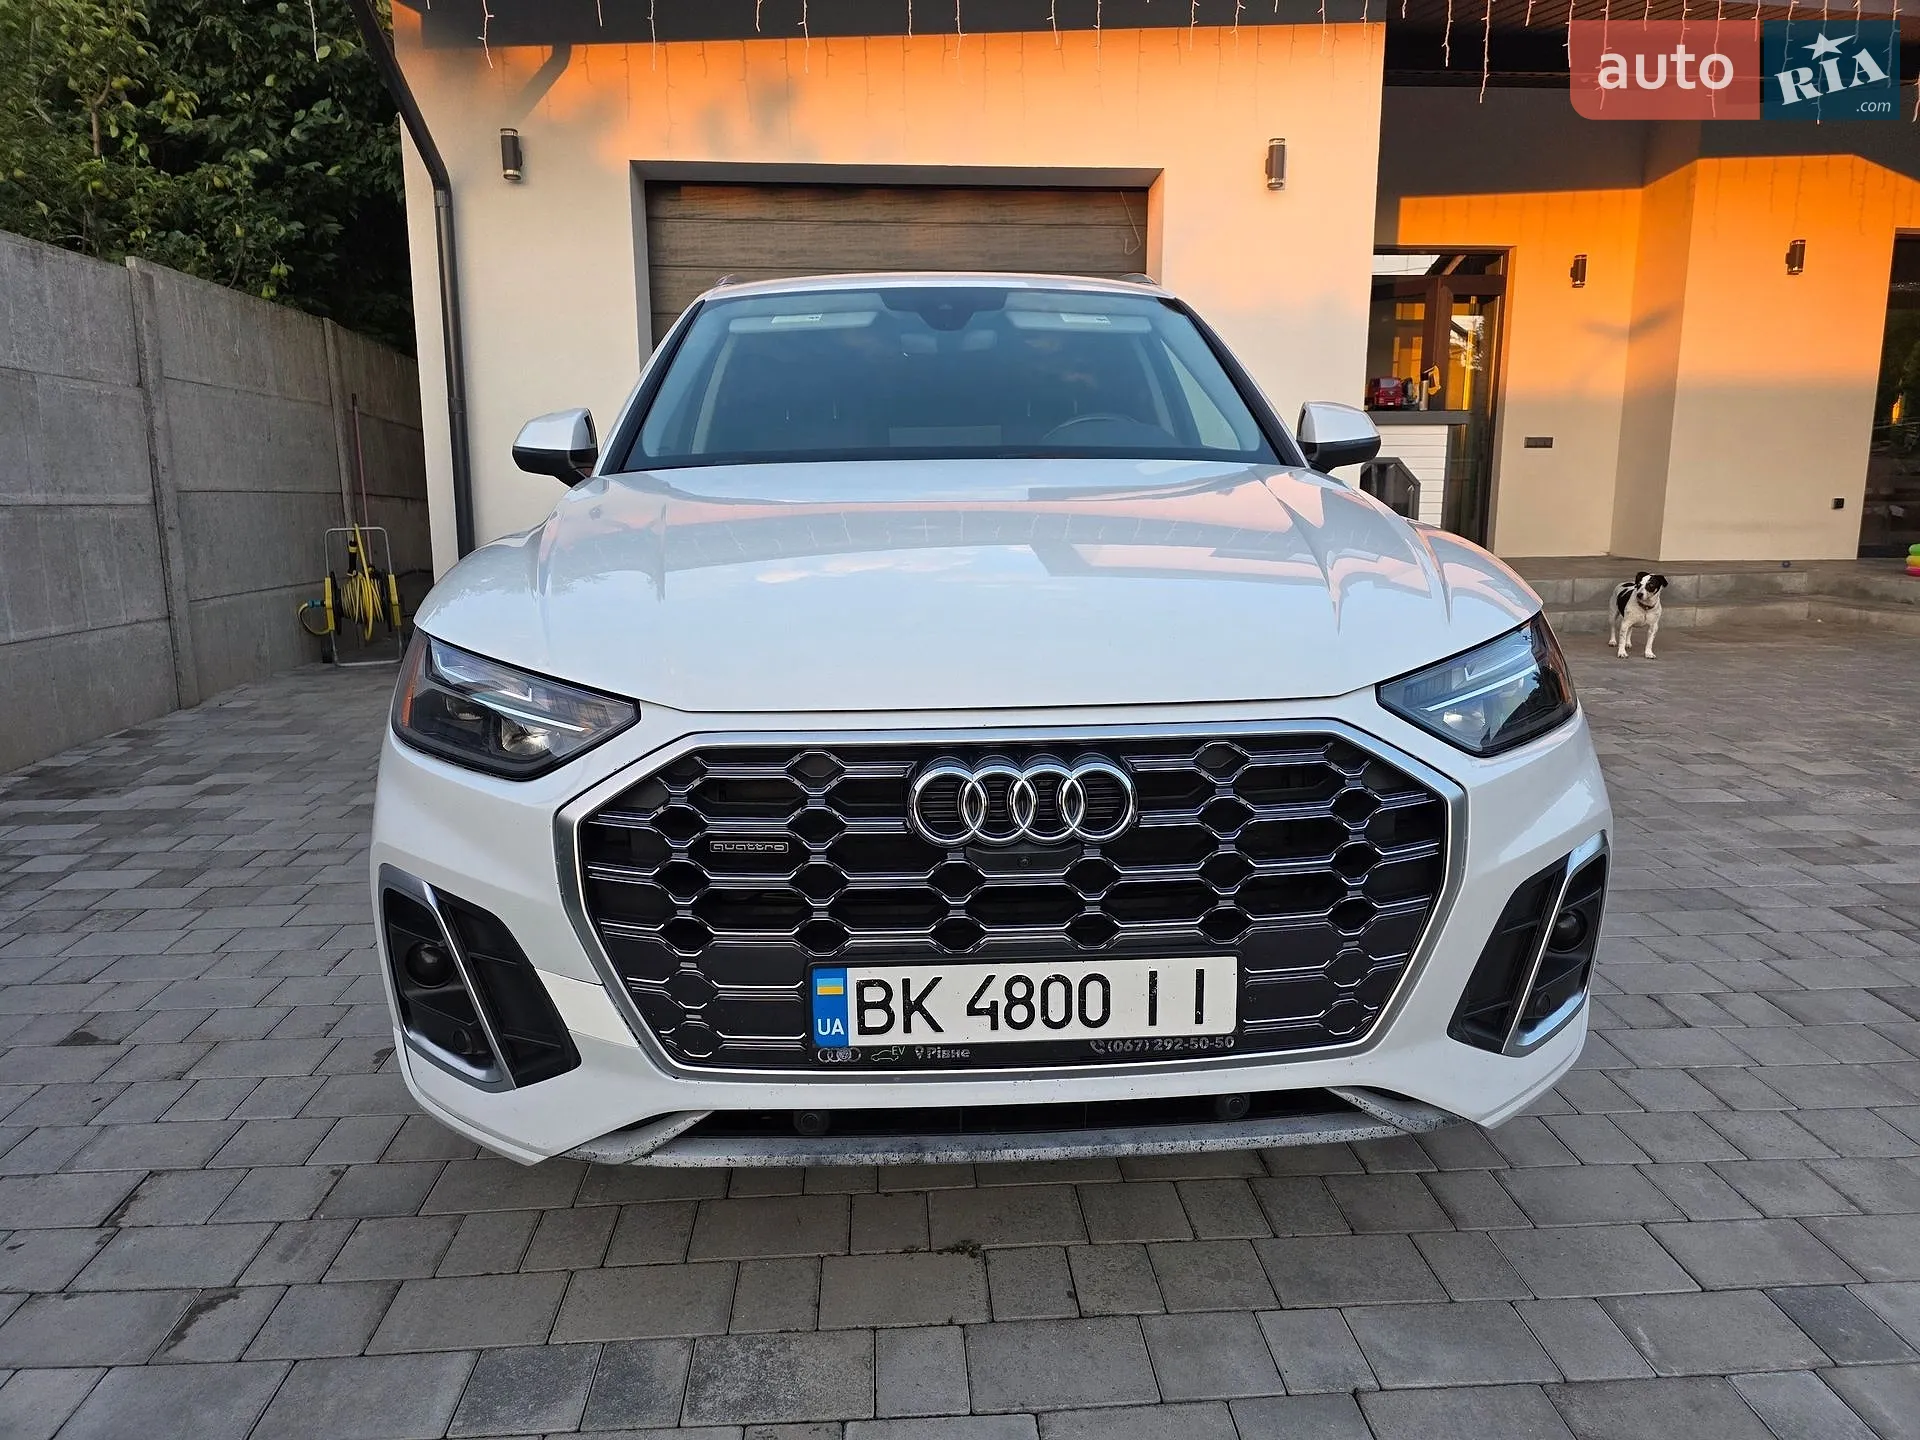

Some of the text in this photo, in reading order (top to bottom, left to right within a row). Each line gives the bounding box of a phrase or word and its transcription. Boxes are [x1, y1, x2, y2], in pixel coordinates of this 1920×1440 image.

[713, 843, 785, 851] quattro
[856, 976, 944, 1036] BK
[966, 973, 1111, 1031] 4800
[817, 1018, 845, 1035] UA
[1107, 1036, 1235, 1052] (067) 292-50-50
